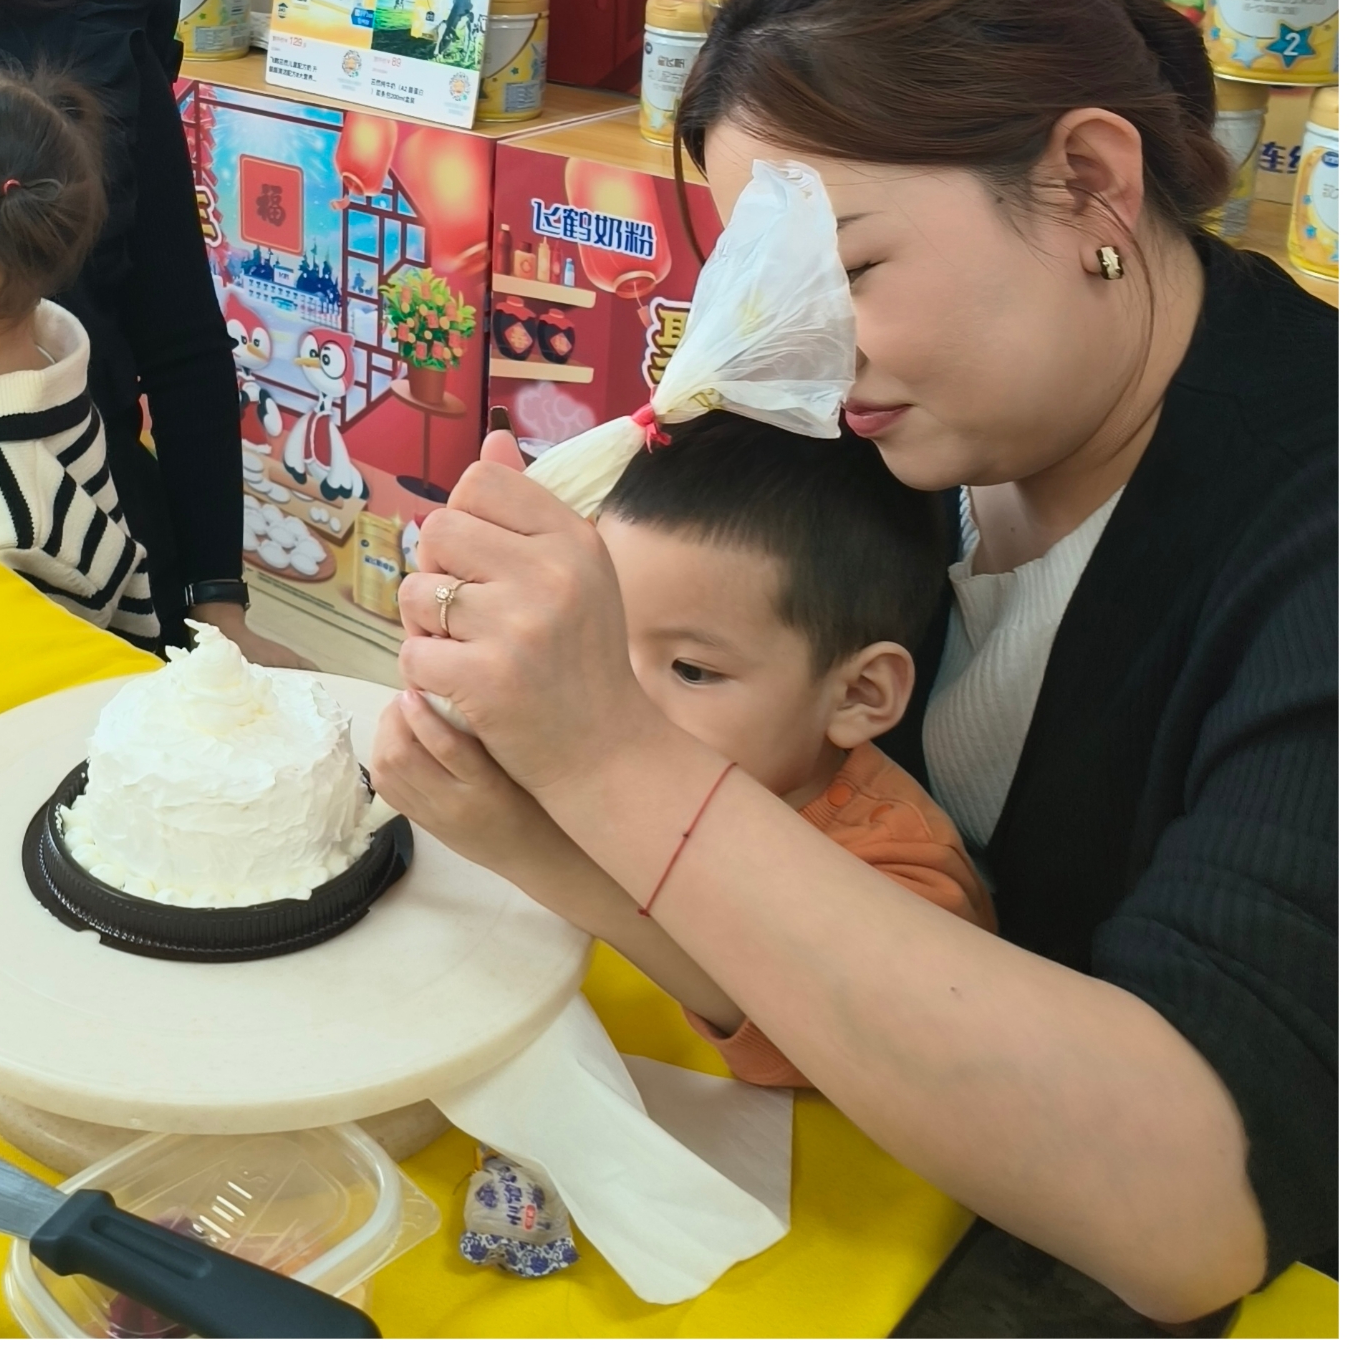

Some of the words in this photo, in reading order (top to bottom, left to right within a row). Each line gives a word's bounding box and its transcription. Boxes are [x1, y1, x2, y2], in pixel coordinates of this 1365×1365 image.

[1284, 32, 1301, 56] 2
[255, 182, 287, 228] 福
[533, 200, 655, 258] 飞鹤奶粉
